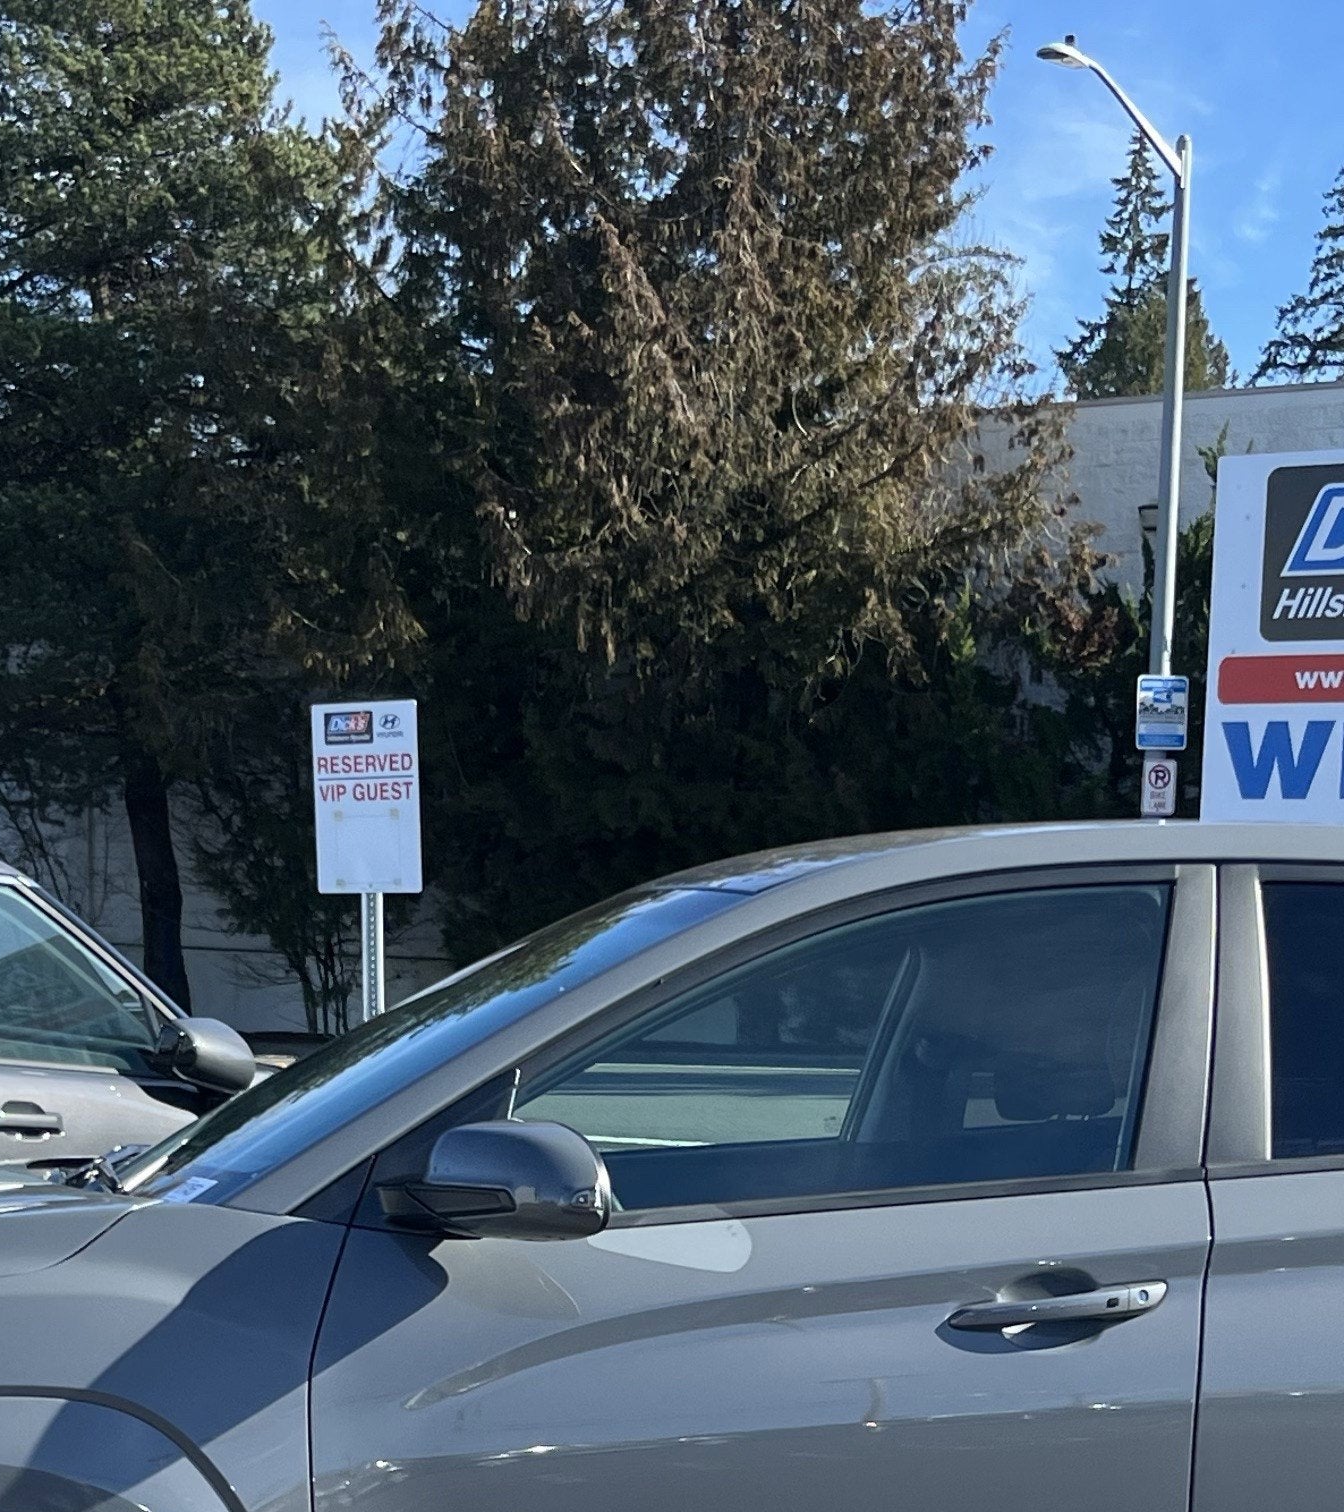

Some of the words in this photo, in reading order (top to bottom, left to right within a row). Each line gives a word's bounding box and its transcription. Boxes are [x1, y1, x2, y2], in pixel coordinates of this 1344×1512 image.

[317, 753, 413, 774] RESERVED
[319, 784, 347, 802] VIP
[352, 781, 414, 801] GUEST
